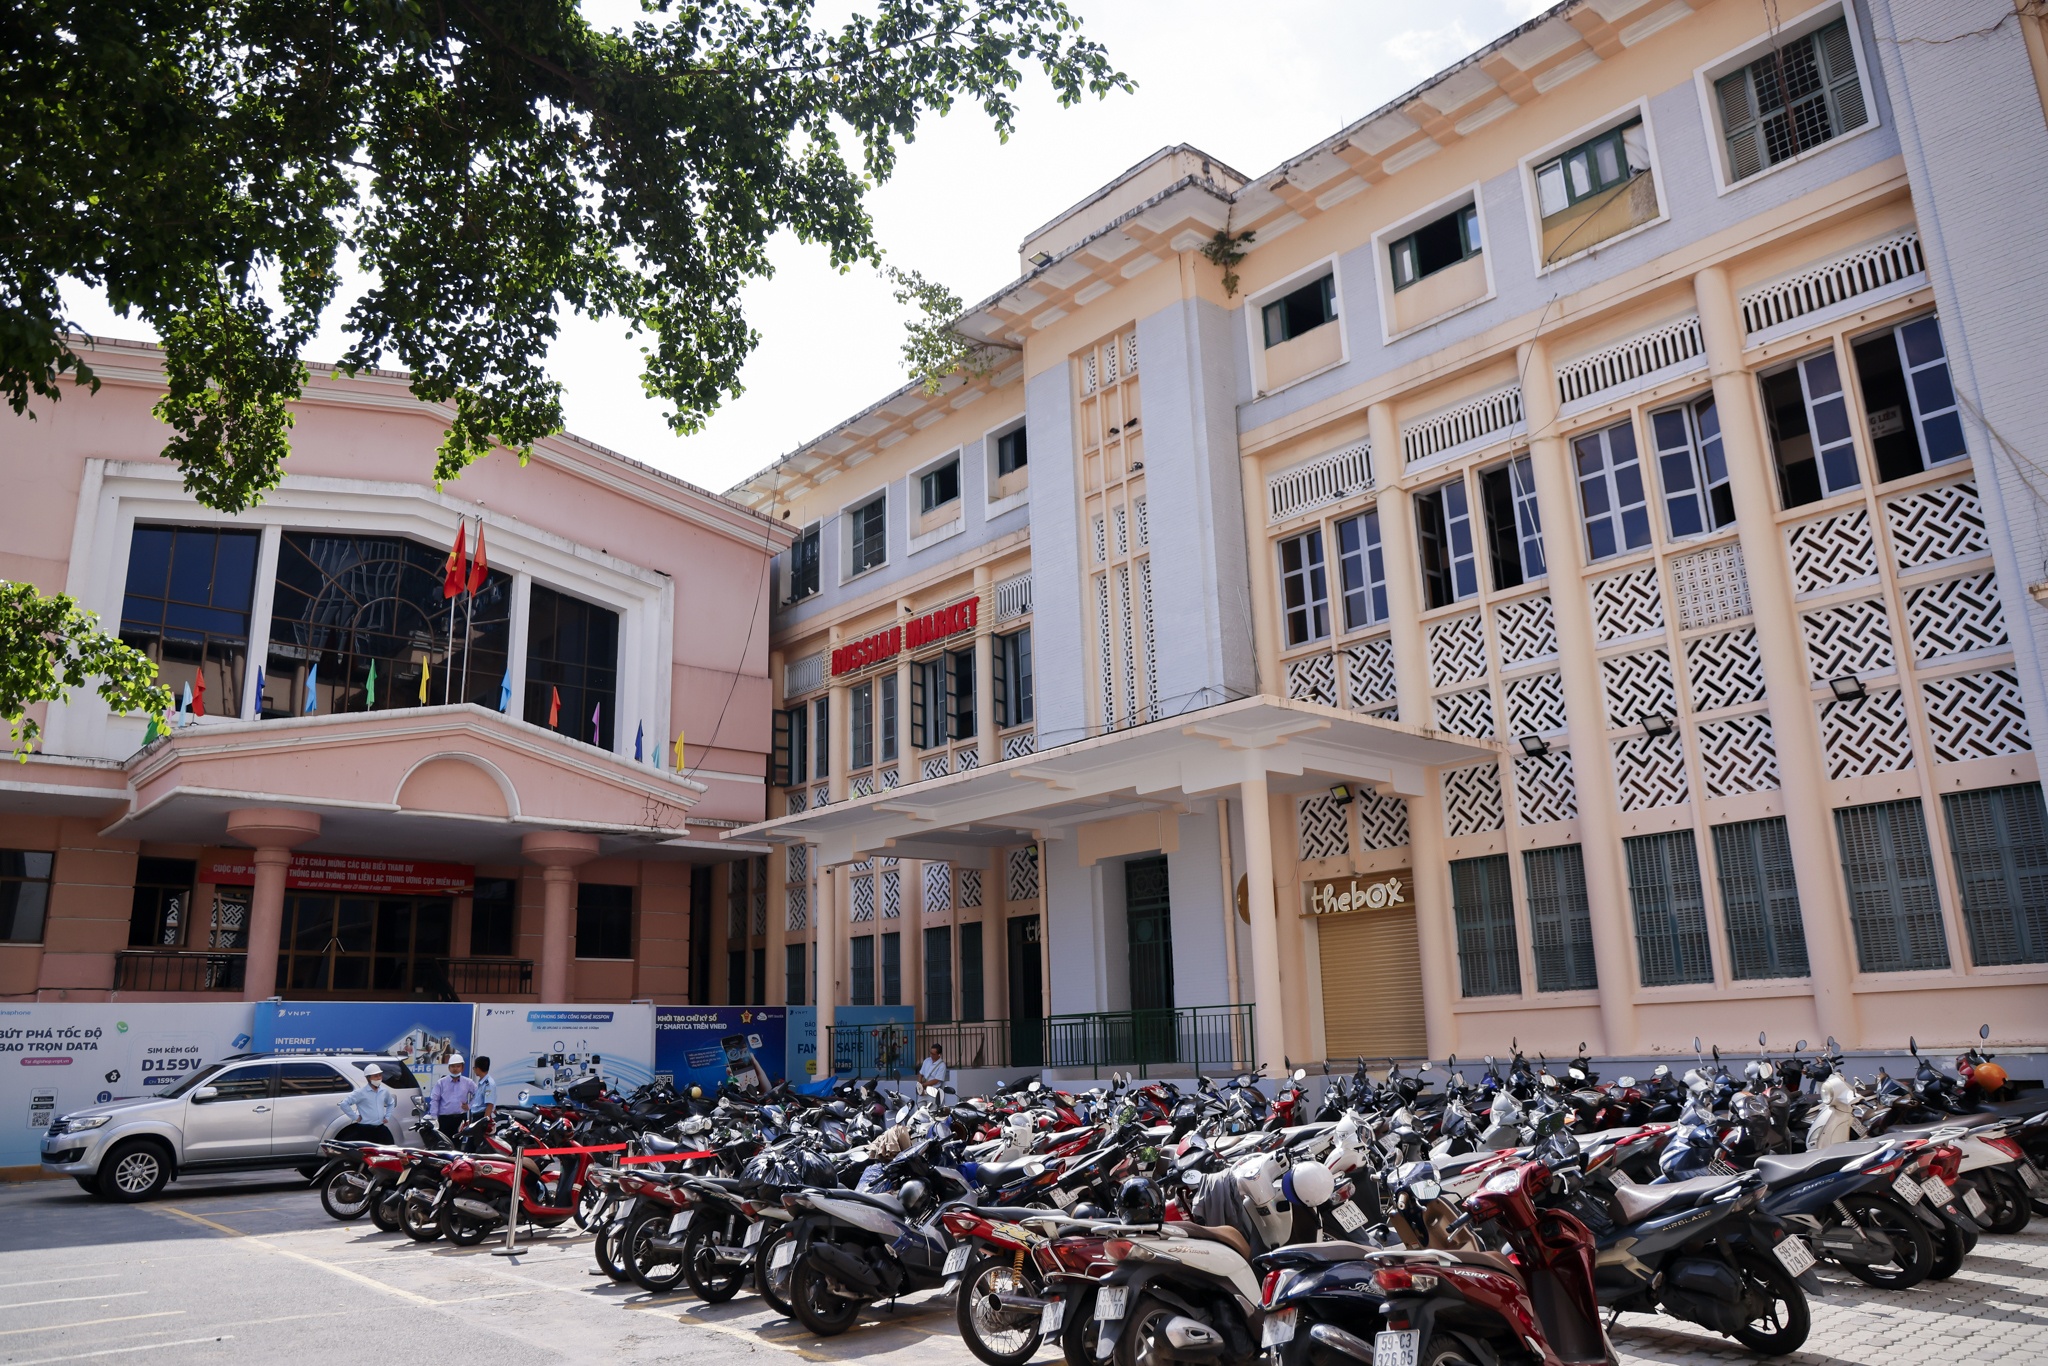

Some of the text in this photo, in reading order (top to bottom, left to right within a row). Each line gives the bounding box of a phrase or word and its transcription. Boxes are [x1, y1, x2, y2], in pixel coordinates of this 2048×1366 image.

[831, 595, 980, 676] RUSSIAN MARKET
[213, 864, 232, 875] CUỘC
[387, 862, 404, 872] THAM
[310, 870, 324, 879] BAN
[346, 871, 357, 881] TIN
[384, 874, 405, 884] TRUNG
[451, 878, 466, 888] NAM
[1311, 877, 1404, 914] thebox
[673, 1015, 686, 1023] TẠO
[708, 1012, 718, 1022] SỐ
[693, 1021, 709, 1030] TRÊN
[25, 1027, 53, 1039] PHÁ
[57, 1025, 82, 1038] TỐC
[84, 1027, 103, 1040] ĐỘ
[275, 1037, 316, 1045] INTERNET
[0, 1042, 98, 1053] BAO TRỌN DATA
[164, 1045, 183, 1054] KÈM
[184, 1045, 199, 1054] GÓI
[836, 1042, 865, 1053] SAFE
[141, 1058, 202, 1071] D159V
[1787, 1250, 1812, 1273] 179.01
[1453, 1269, 1490, 1279] VISION
[1381, 1333, 1412, 1351] 59-C3
[1377, 1350, 1413, 1366] 326.85
